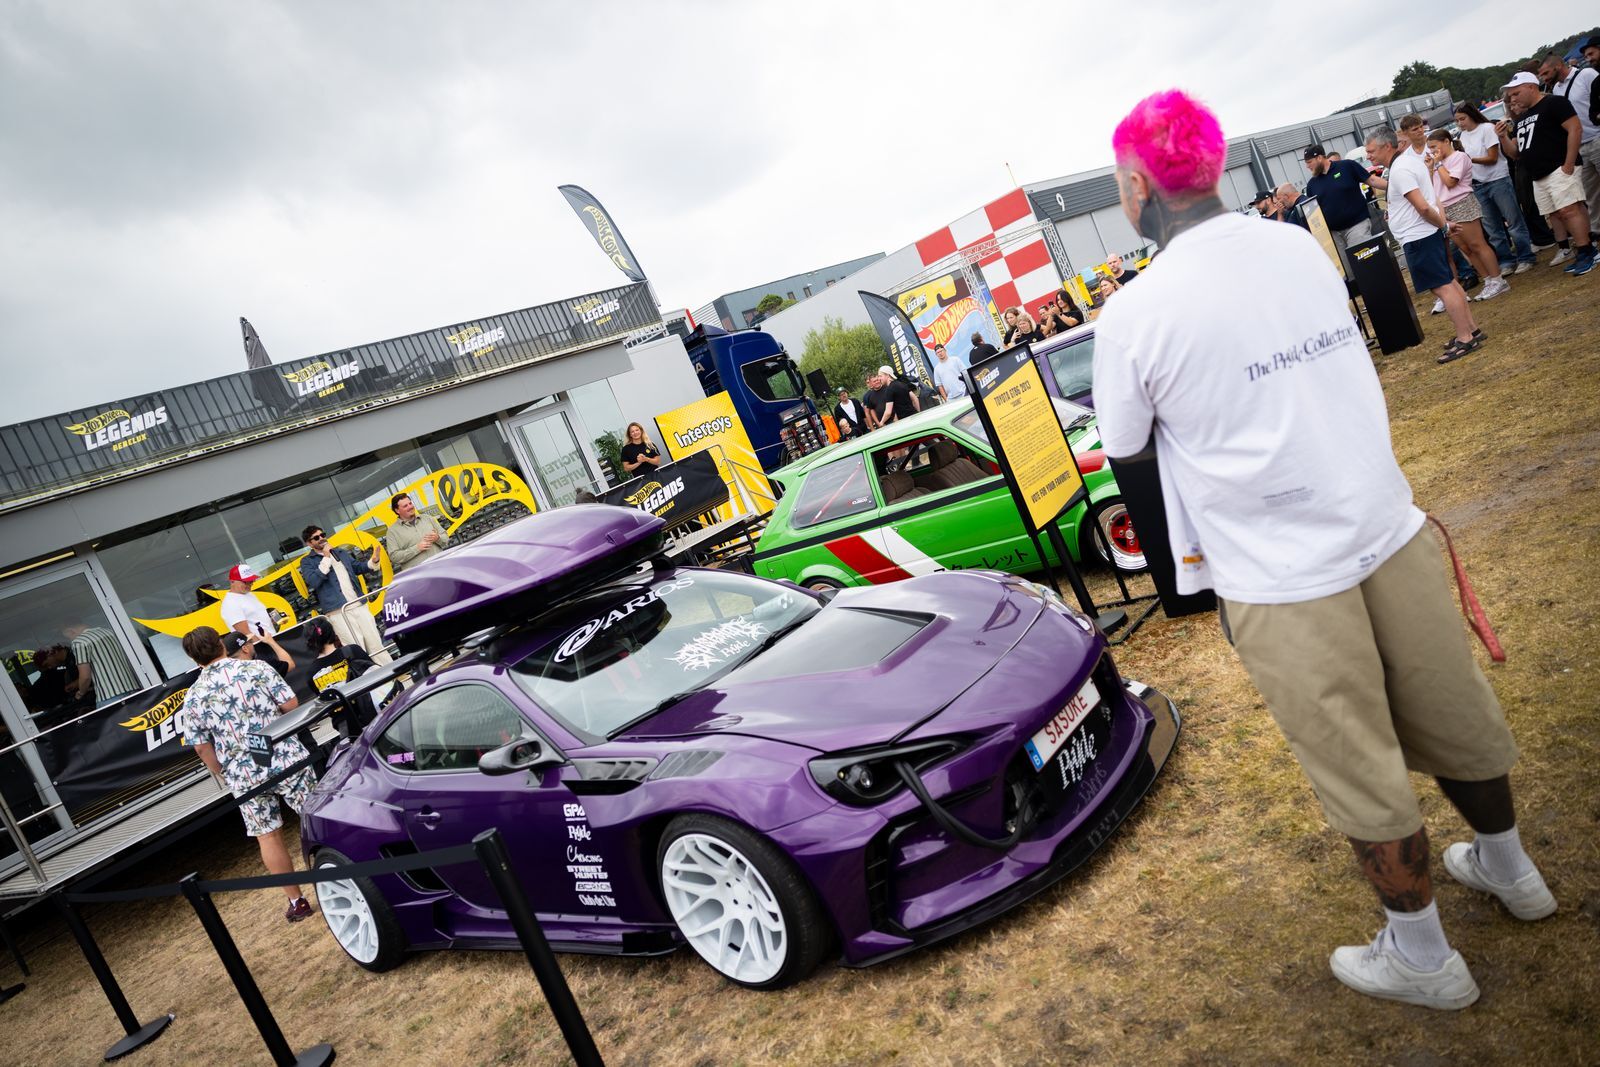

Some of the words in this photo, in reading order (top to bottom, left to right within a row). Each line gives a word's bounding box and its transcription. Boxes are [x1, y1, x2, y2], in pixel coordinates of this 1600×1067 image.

[1516, 121, 1535, 153] 67
[1055, 192, 1066, 212] 9
[582, 298, 620, 325] LEGENDS
[457, 326, 505, 356] LEGENDS
[297, 360, 360, 397] LEGENDS
[1244, 361, 1272, 382] The
[993, 391, 1011, 407] TOYOTA
[1020, 379, 1032, 393] 2013
[82, 416, 101, 434] HOT
[84, 406, 168, 451] LEGENDS
[674, 416, 732, 448] Intertoys
[112, 433, 148, 453] BENELUX
[637, 476, 685, 513] LEGENDS
[1039, 486, 1048, 498] FOR
[143, 706, 166, 728] HOT
[1043, 693, 1088, 745] SASUKE
[1033, 754, 1041, 767] B
[563, 803, 586, 817] GPA
[566, 865, 603, 873] STREET
